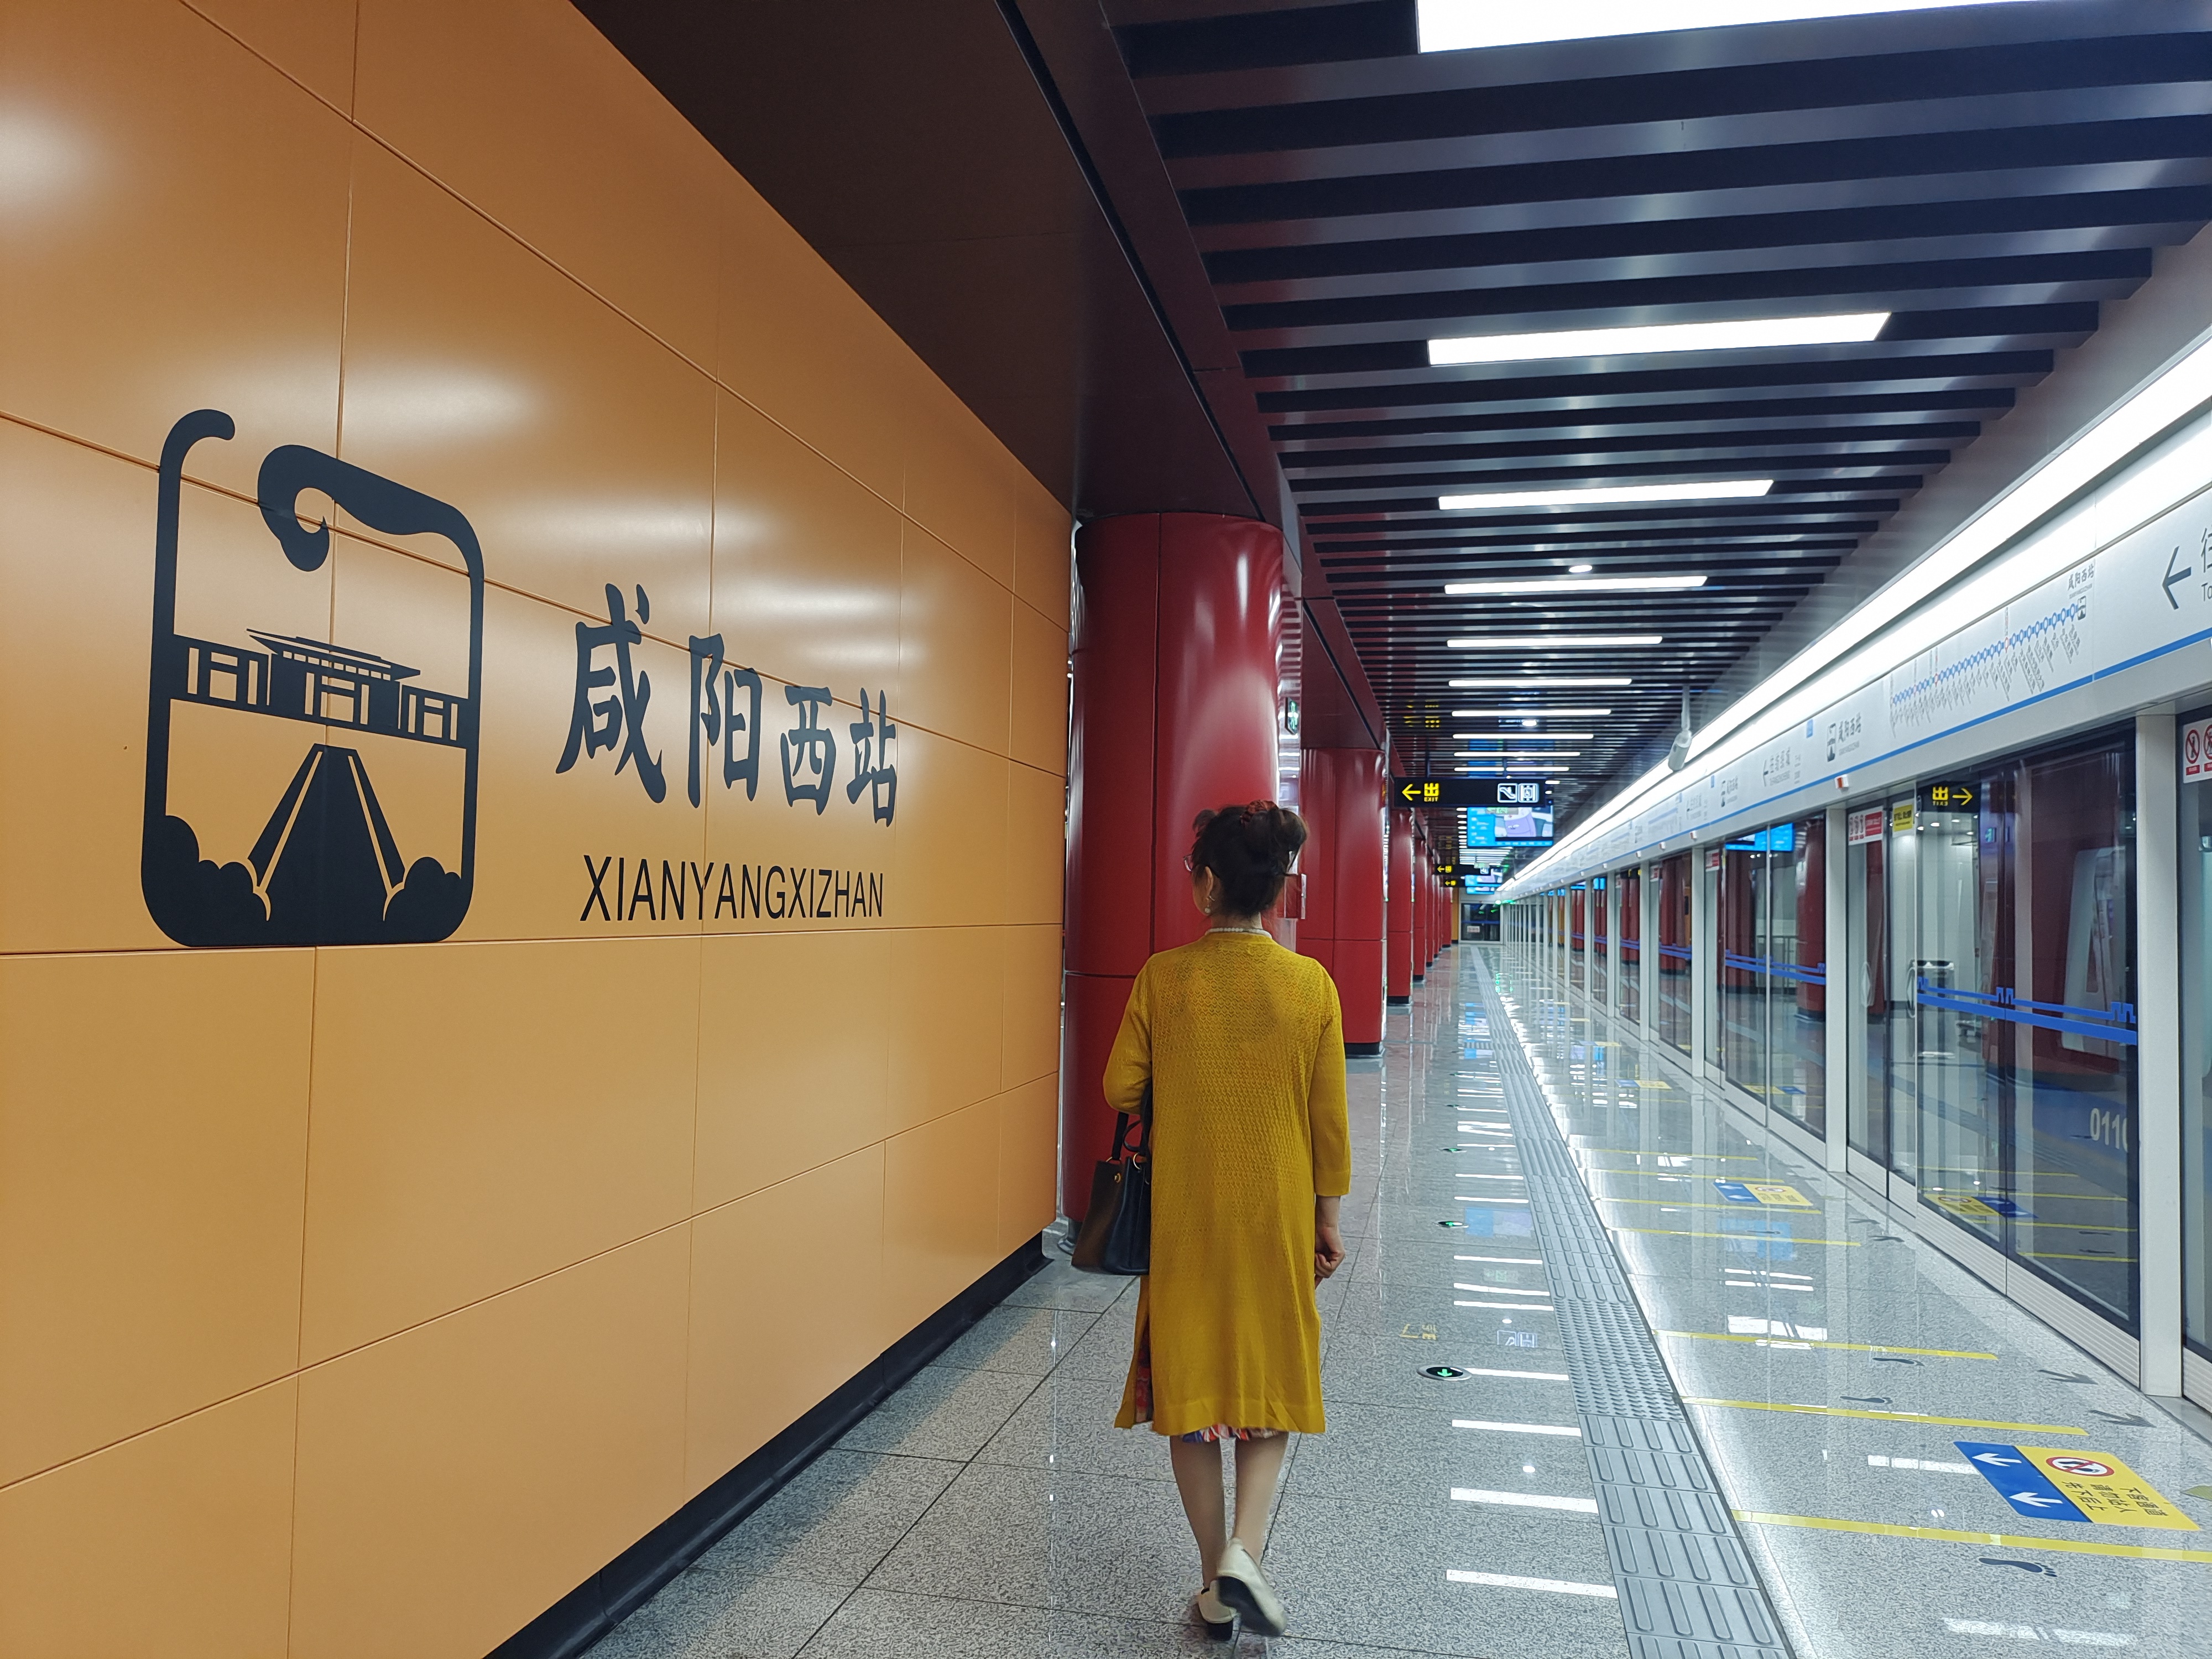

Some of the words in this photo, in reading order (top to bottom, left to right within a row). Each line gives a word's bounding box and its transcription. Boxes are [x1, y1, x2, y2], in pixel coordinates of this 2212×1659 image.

[556, 583, 896, 827] 咸阳西站
[1424, 782, 1439, 796] 出
[580, 855, 883, 921] XIANYANGXIZHAN
[2061, 1481, 2108, 1511] 先下后上
[2090, 1484, 2137, 1513] 请勿站人
[2120, 1487, 2169, 1516] 下客通道
